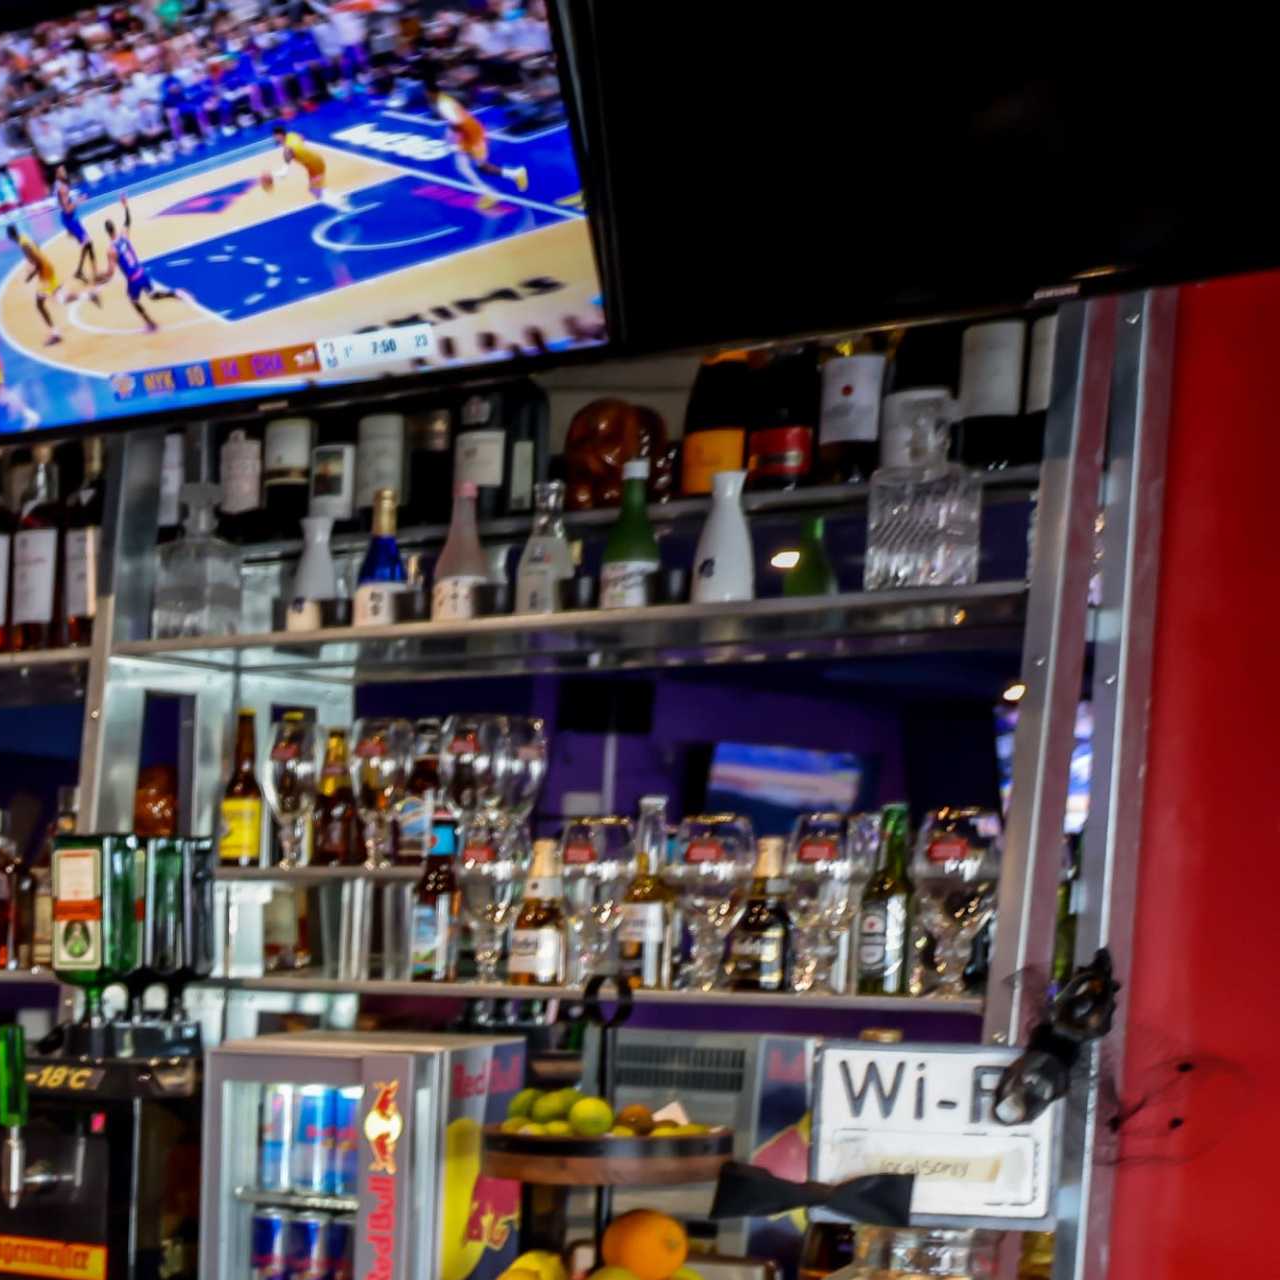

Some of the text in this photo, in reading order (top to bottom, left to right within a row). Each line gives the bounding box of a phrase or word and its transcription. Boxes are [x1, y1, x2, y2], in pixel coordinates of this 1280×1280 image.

[143, 370, 175, 396] NYK
[453, 1063, 487, 1099] Red
[839, 1059, 1012, 1124] Wi-F
[367, 1174, 397, 1235] Bull
